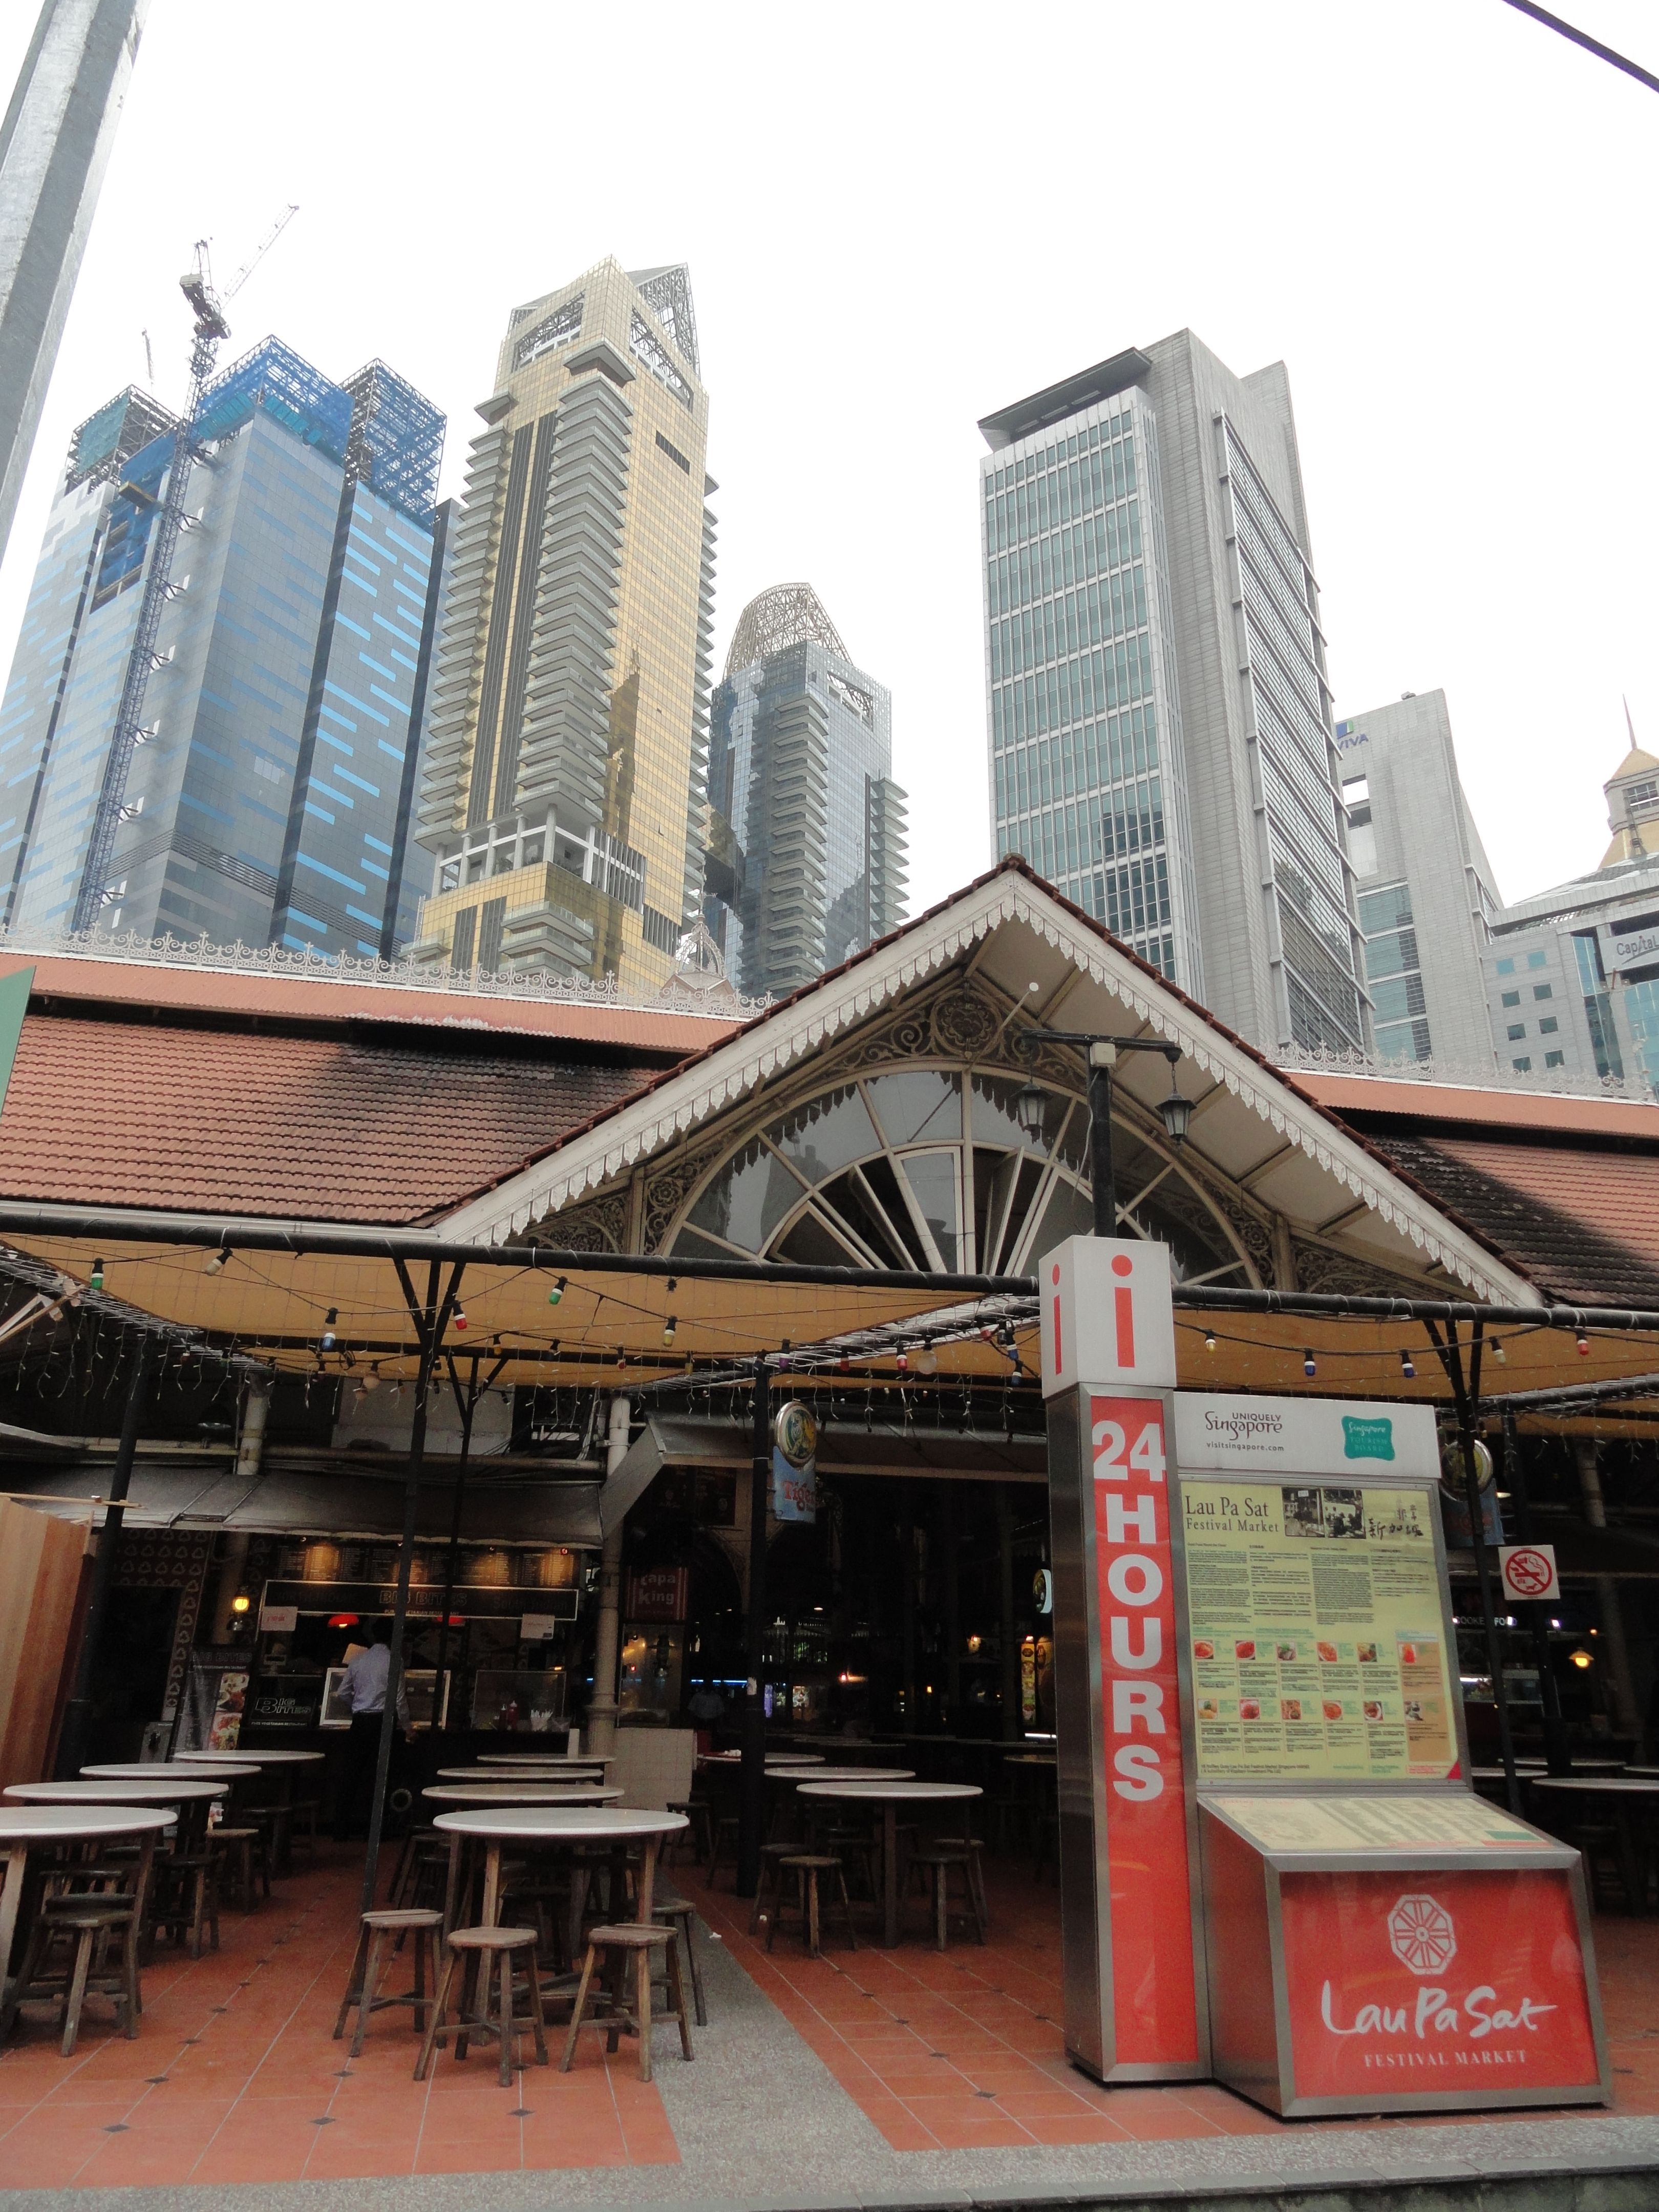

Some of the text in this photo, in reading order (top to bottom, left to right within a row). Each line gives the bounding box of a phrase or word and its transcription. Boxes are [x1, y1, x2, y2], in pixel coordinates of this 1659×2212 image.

[1205, 1411, 1283, 1440] Singapore
[1232, 1412, 1281, 1422] UNIQUELY
[1206, 1441, 1284, 1452] visitsingapore.com
[1185, 1495, 1269, 1517] Lau Pa Sat
[1186, 1517, 1279, 1533] Festival Market
[638, 1588, 675, 1605] king
[1092, 1420, 1167, 1802] 24 HOURS
[1453, 1615, 1485, 1625] COOKE
[1321, 1980, 1558, 2039] Lau Pa Sat
[1364, 2050, 1527, 2067] FESTIVAL MARKET
